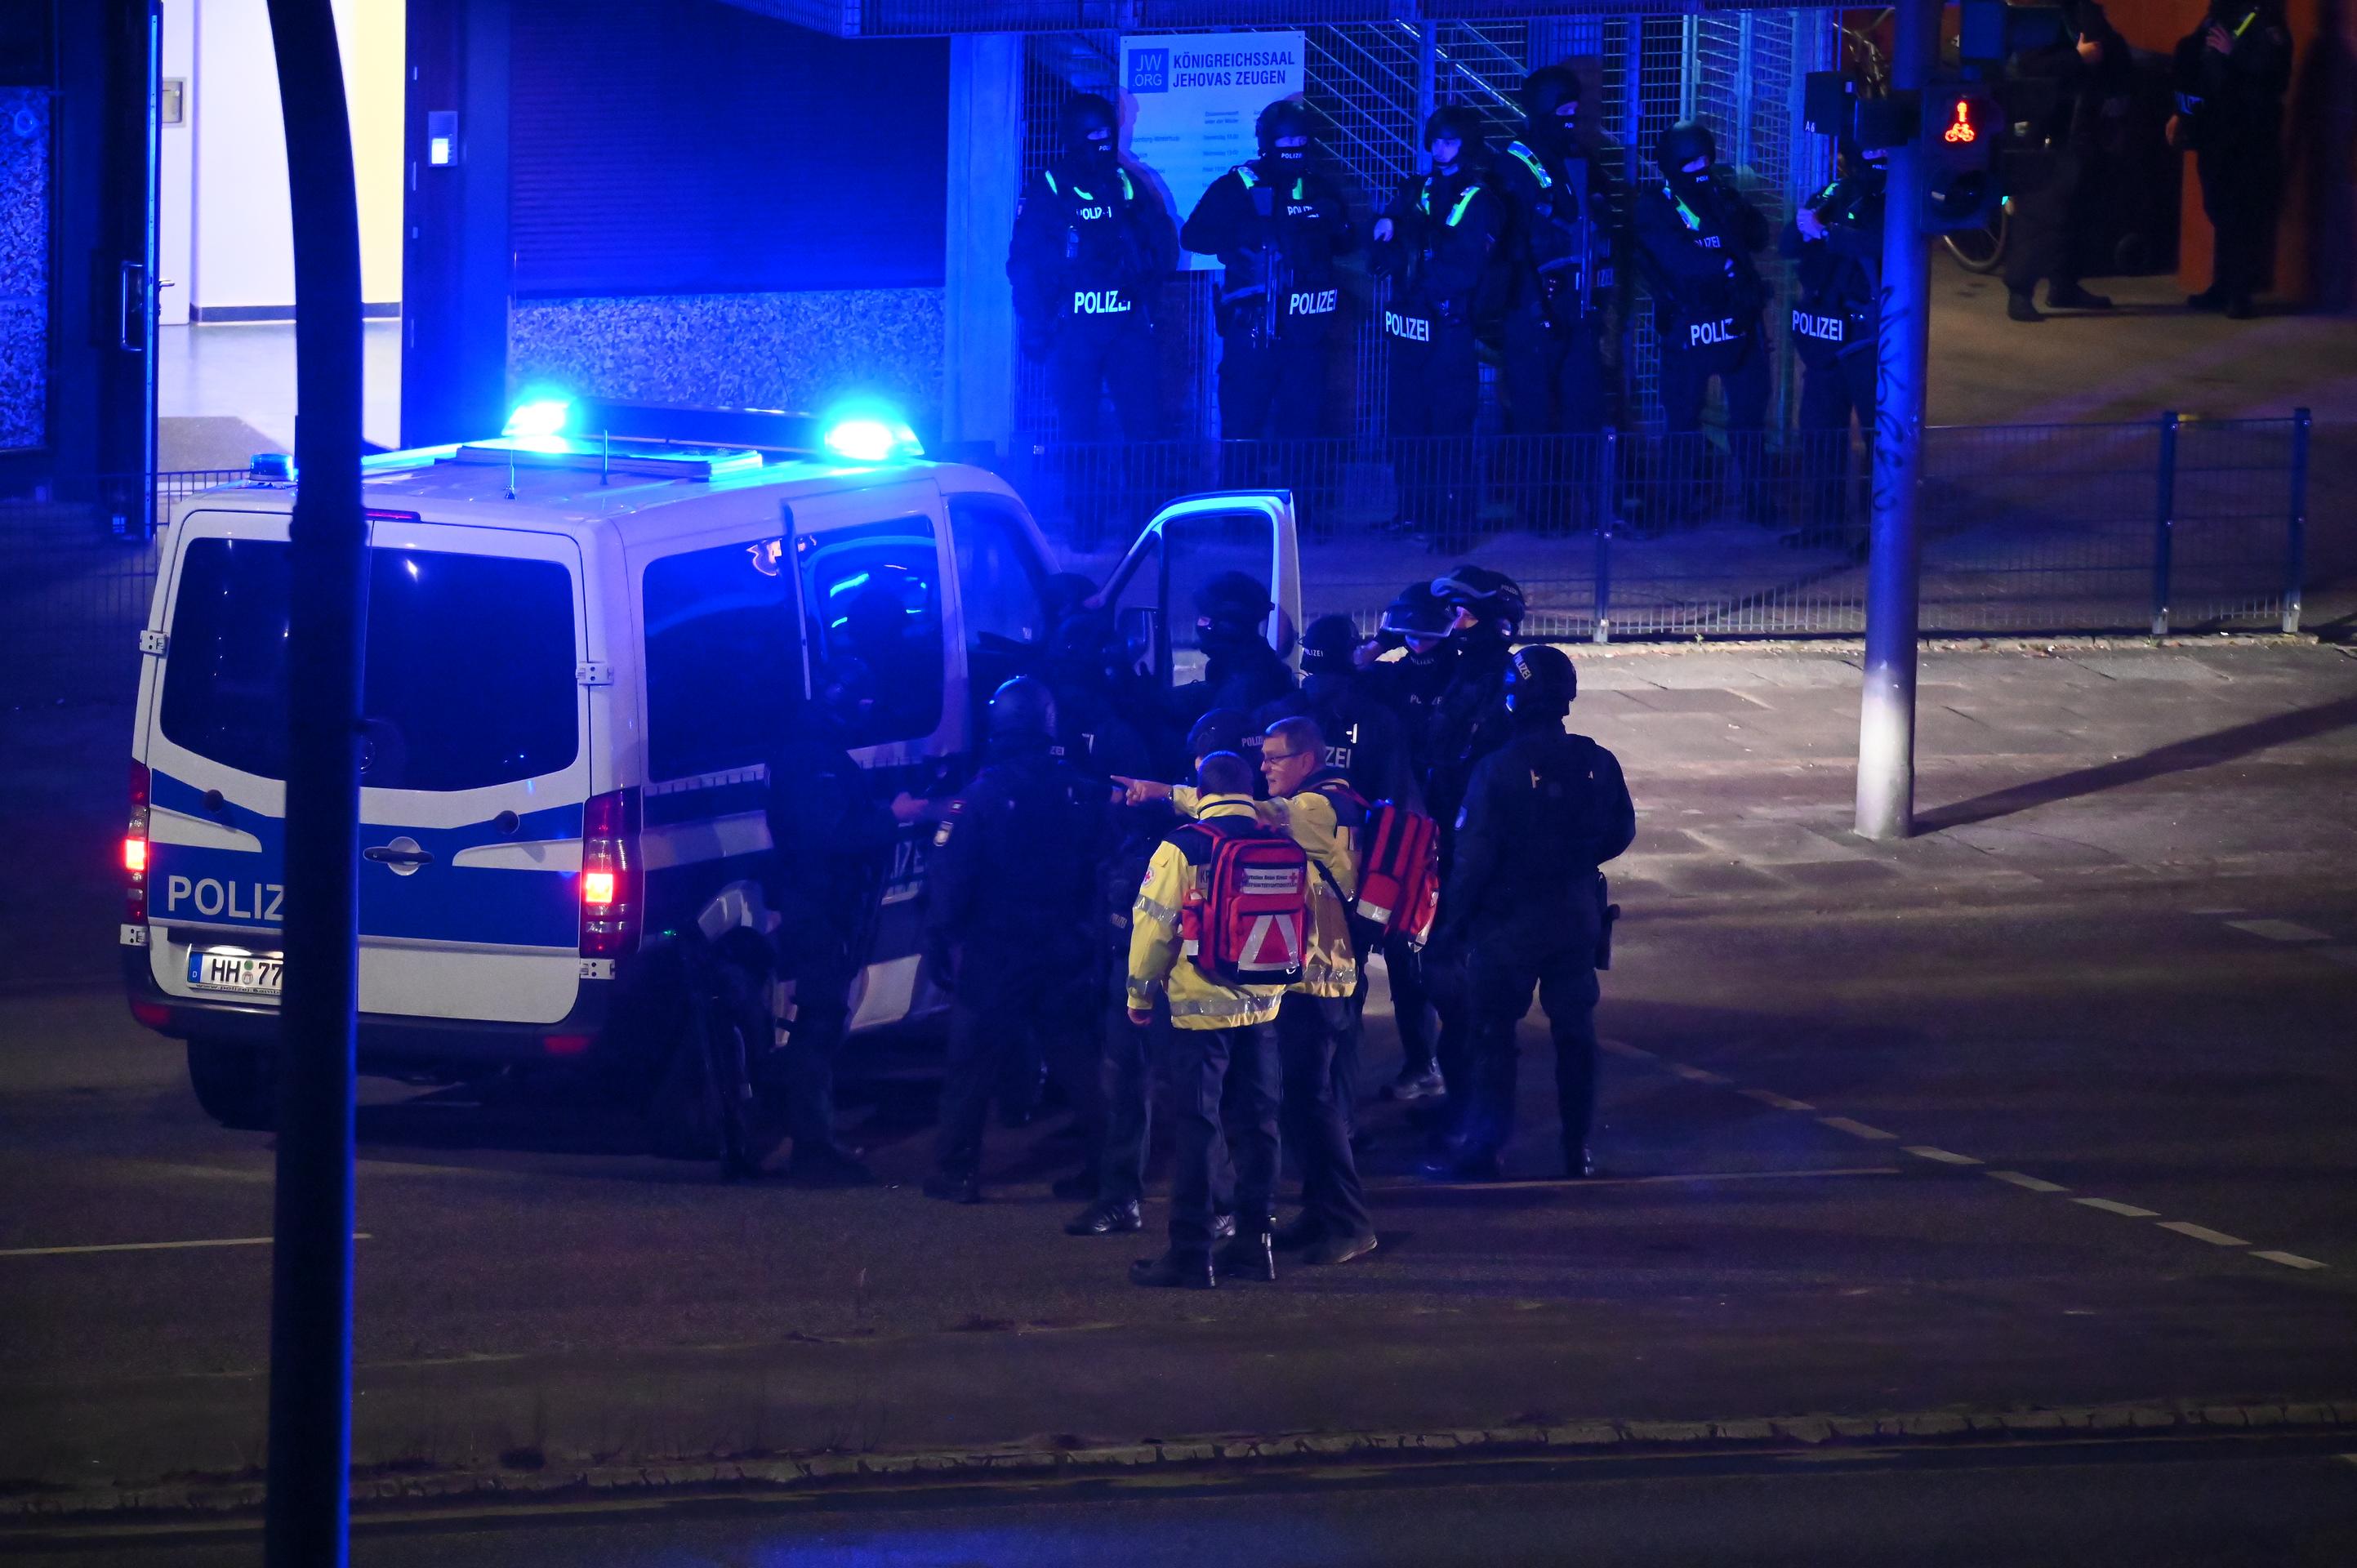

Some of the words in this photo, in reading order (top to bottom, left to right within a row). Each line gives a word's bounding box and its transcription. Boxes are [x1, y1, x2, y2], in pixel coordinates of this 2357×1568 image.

[1136, 54, 1162, 72] JW
[1174, 51, 1294, 69] KÖNIGREICHSSAAL
[1173, 72, 1232, 87] JEHOVAS
[1236, 70, 1286, 85] ZEUGEN
[1289, 288, 1338, 315] POLIZEI
[1385, 310, 1429, 341] POLIZEI
[1690, 318, 1740, 346] POLIZ
[1792, 310, 1842, 341] POLIZEI
[1241, 736, 1263, 747] POLIZ
[168, 875, 284, 920] POLIZ
[192, 970, 198, 978] D
[211, 959, 241, 982] HH
